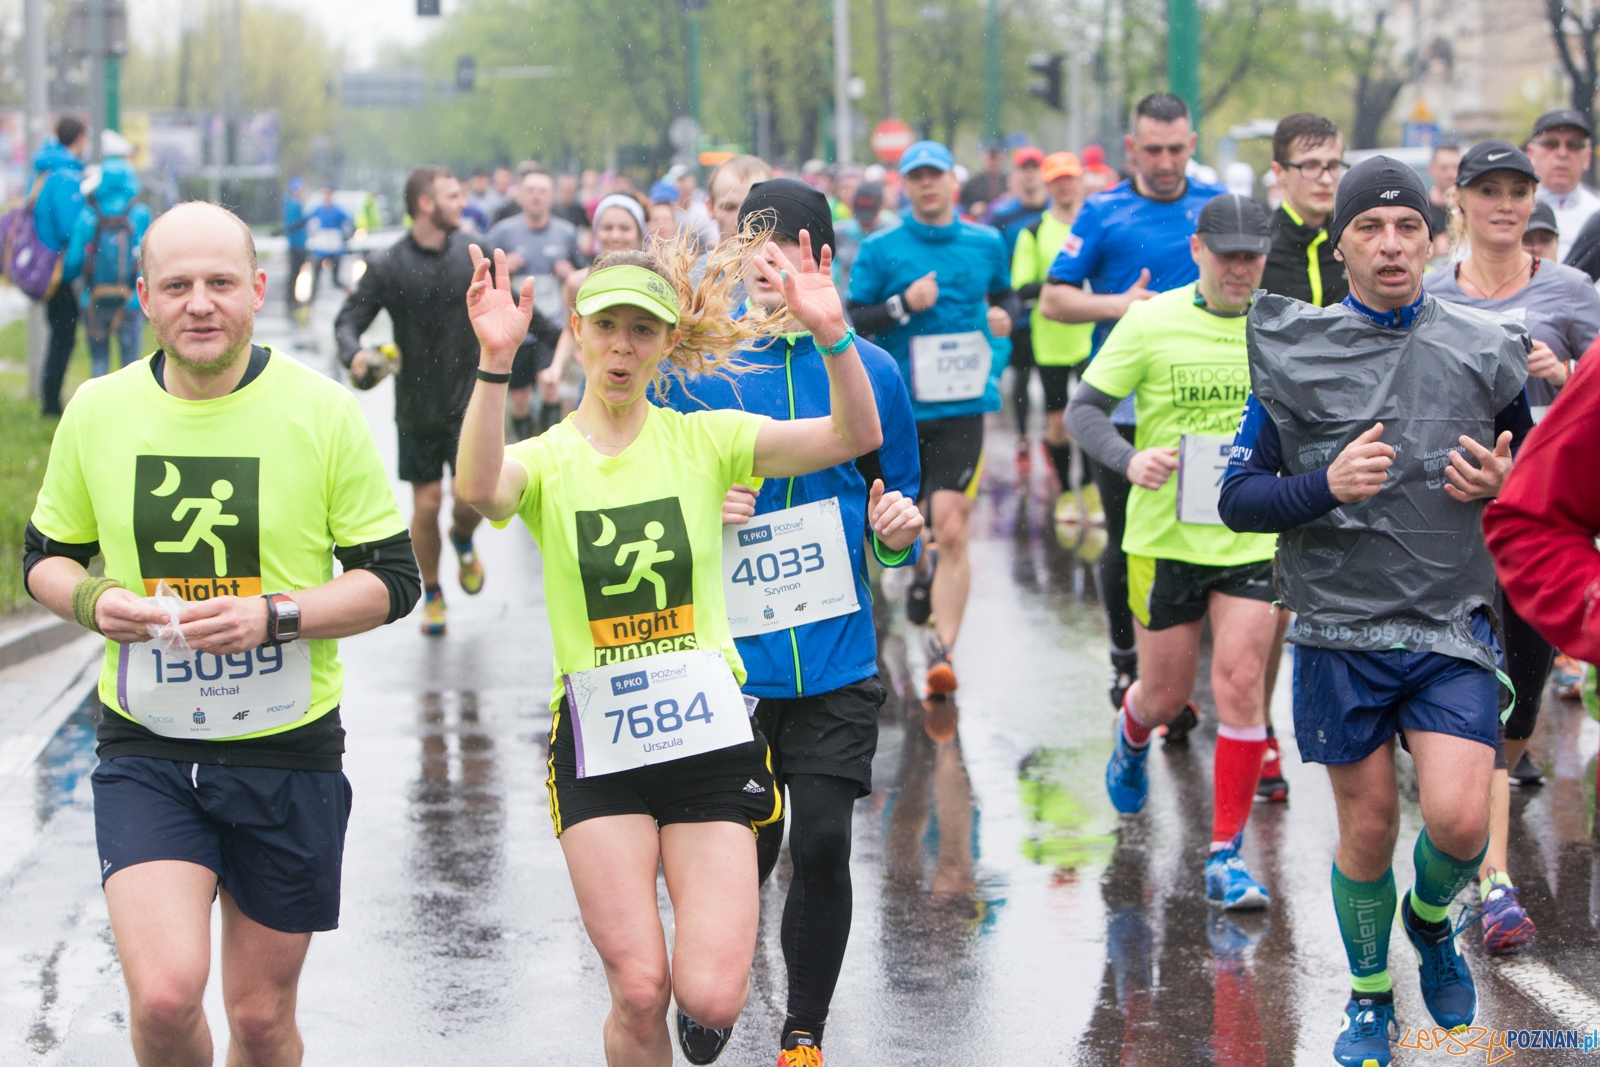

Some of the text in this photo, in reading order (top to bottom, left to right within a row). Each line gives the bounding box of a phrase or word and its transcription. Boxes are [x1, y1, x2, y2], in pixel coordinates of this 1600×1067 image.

[1380, 190, 1400, 199] 4F
[1177, 367, 1248, 383] BYDGO
[1179, 385, 1252, 401] TRIATH
[731, 542, 825, 586] 4033
[764, 582, 801, 597] Szymon
[612, 609, 679, 641] night
[1320, 624, 1352, 641] 109
[1362, 626, 1396, 642] 109
[1406, 626, 1438, 644] 109
[595, 634, 699, 667] runners
[151, 643, 283, 683] 13099
[200, 685, 240, 697] Michał
[604, 691, 714, 744] 7684
[643, 737, 684, 753] Urszula
